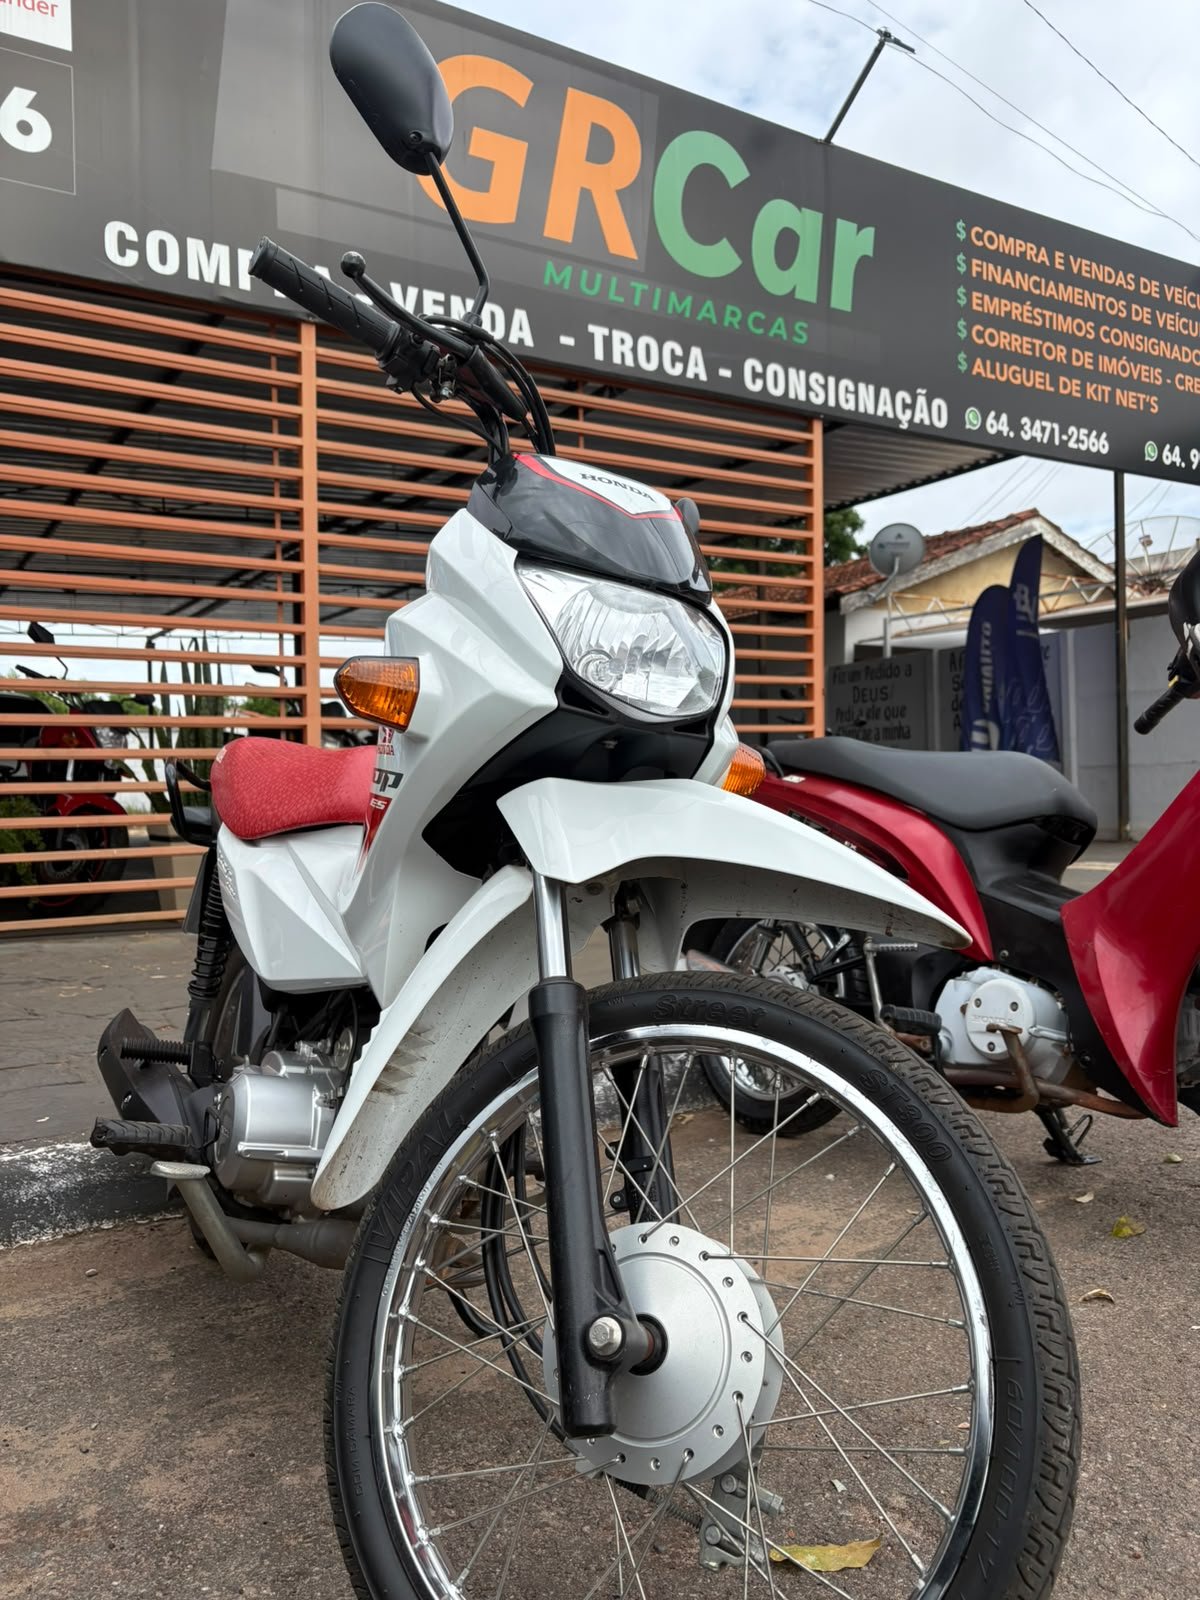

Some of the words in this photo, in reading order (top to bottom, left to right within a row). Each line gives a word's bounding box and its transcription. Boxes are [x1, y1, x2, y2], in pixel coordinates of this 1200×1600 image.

[970, 226, 1050, 267] COMPRA
[1054, 251, 1065, 271] E
[1069, 255, 1136, 291] VENDAS
[1139, 276, 1160, 299] DE
[542, 260, 810, 346] MULTIMARCAS
[971, 257, 1128, 319] FINANCIAMENTOS
[1131, 303, 1152, 326] DE
[971, 291, 1095, 340] EMPRÉSTIMOS
[104, 220, 332, 298] COM
[587, 323, 708, 382] TROCA
[743, 357, 949, 430] CONSIGNAÇÃO
[971, 324, 1068, 364] CORRETOR
[1071, 347, 1094, 370] DE
[1098, 353, 1163, 386] IMÓVEIS
[971, 357, 1055, 393] ALUGUEL
[1059, 375, 1082, 398] DE
[1086, 382, 1112, 404] KIT
[985, 409, 1015, 439] 64.
[1020, 416, 1110, 455] 3471-2566
[1161, 443, 1186, 470] 64.
[1189, 448, 1200, 471] 9
[579, 471, 658, 504] HONDA
[648, 992, 769, 1030] Street
[857, 1069, 953, 1163] ST300
